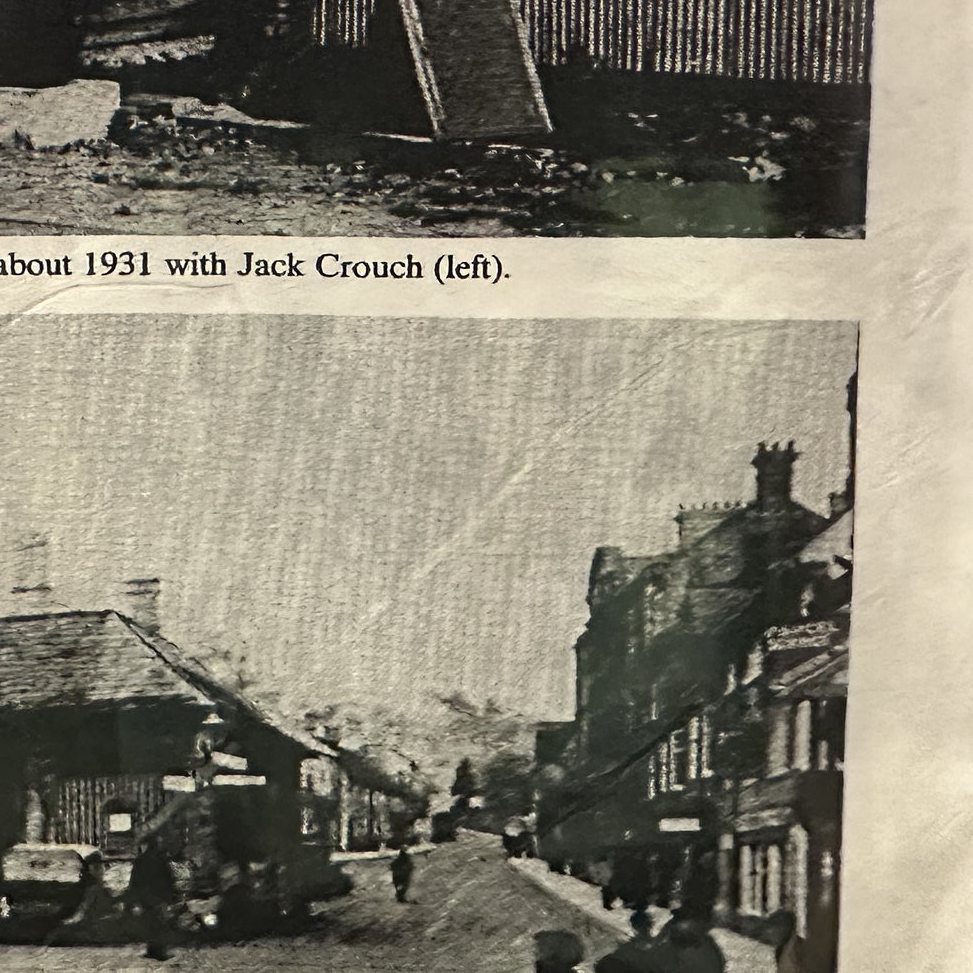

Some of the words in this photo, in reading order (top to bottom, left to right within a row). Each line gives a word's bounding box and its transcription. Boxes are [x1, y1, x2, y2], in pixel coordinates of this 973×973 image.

[85, 252, 151, 277] 1931
[164, 252, 227, 277] with
[236, 252, 306, 278] Jack
[315, 253, 425, 280] Crouch
[434, 254, 511, 285] (left).
